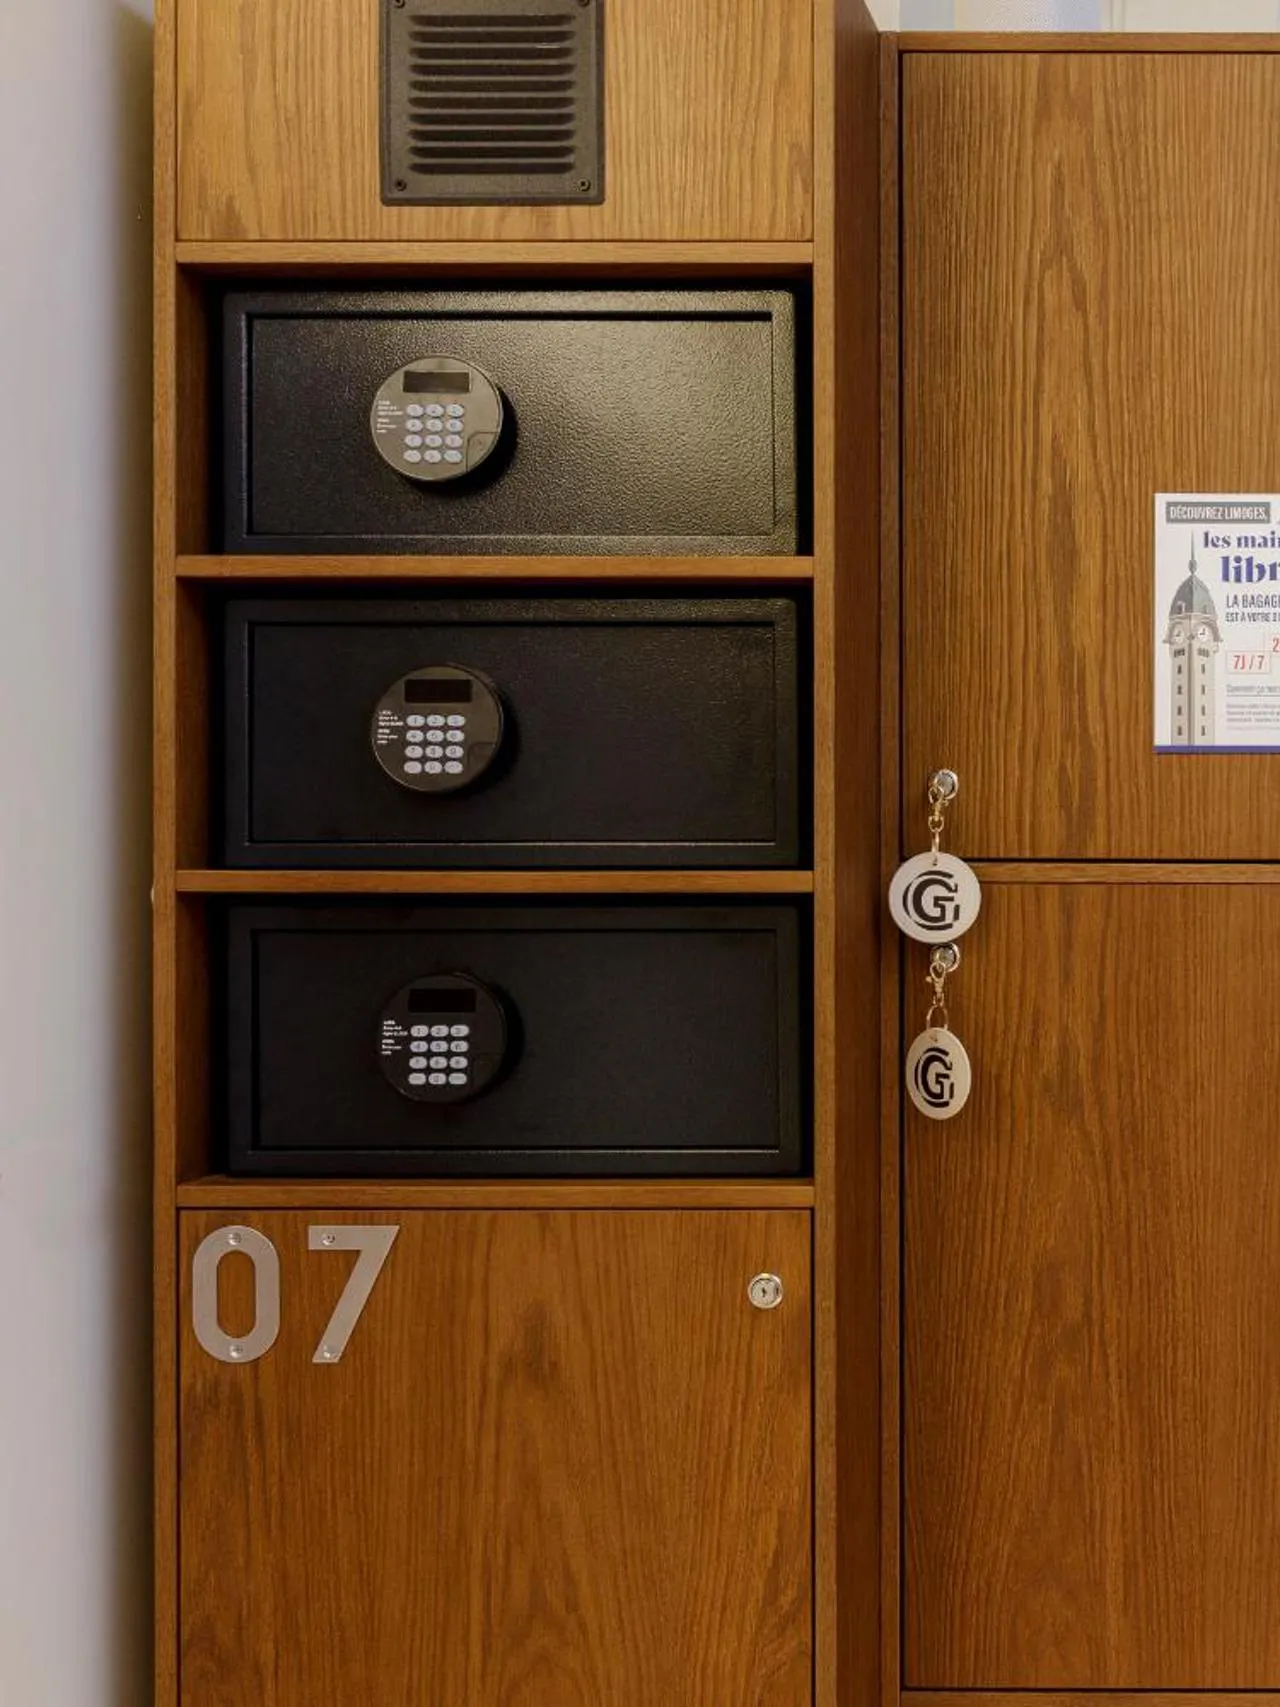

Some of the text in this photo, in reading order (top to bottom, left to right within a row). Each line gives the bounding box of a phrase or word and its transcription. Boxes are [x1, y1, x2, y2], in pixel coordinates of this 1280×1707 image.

[1203, 531, 1231, 548] les
[1226, 594, 1239, 608] LA
[1225, 612, 1239, 622] EST
[192, 1225, 400, 1363] 07
